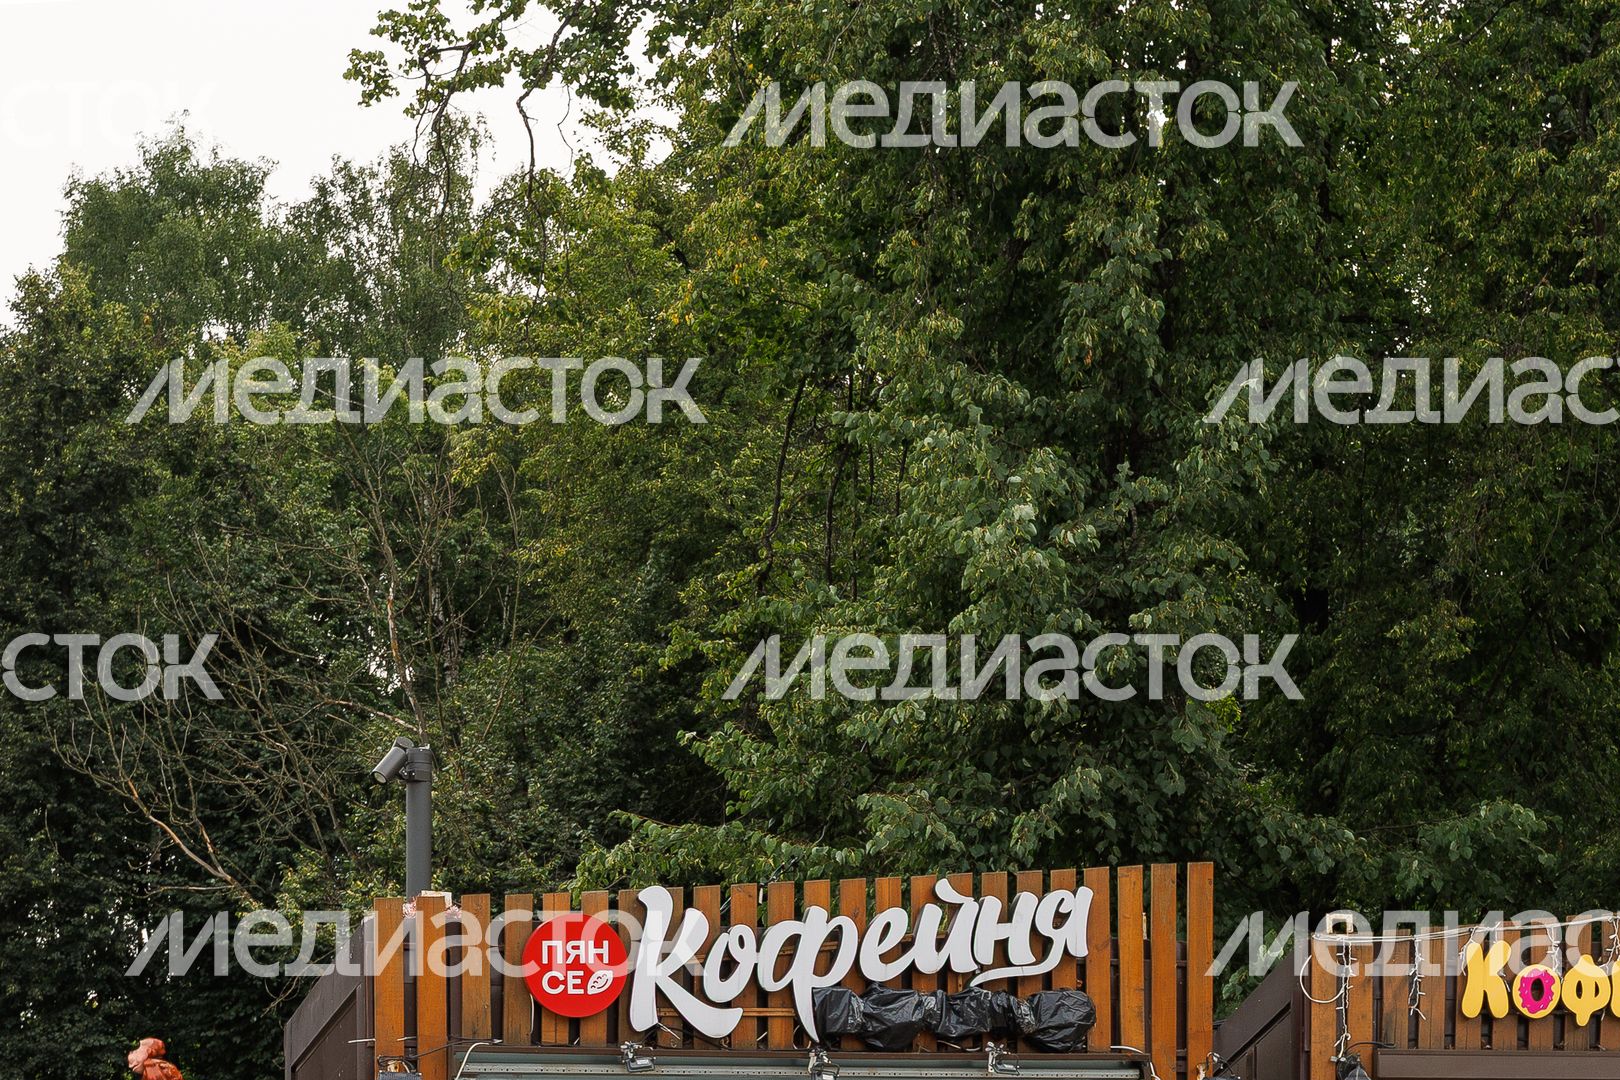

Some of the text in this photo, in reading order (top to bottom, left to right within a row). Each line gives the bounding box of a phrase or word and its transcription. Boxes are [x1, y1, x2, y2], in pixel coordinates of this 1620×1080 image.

[541, 940, 609, 966] ПЯН
[630, 877, 1094, 1043] Кофейня
[541, 970, 584, 995] СЕ
